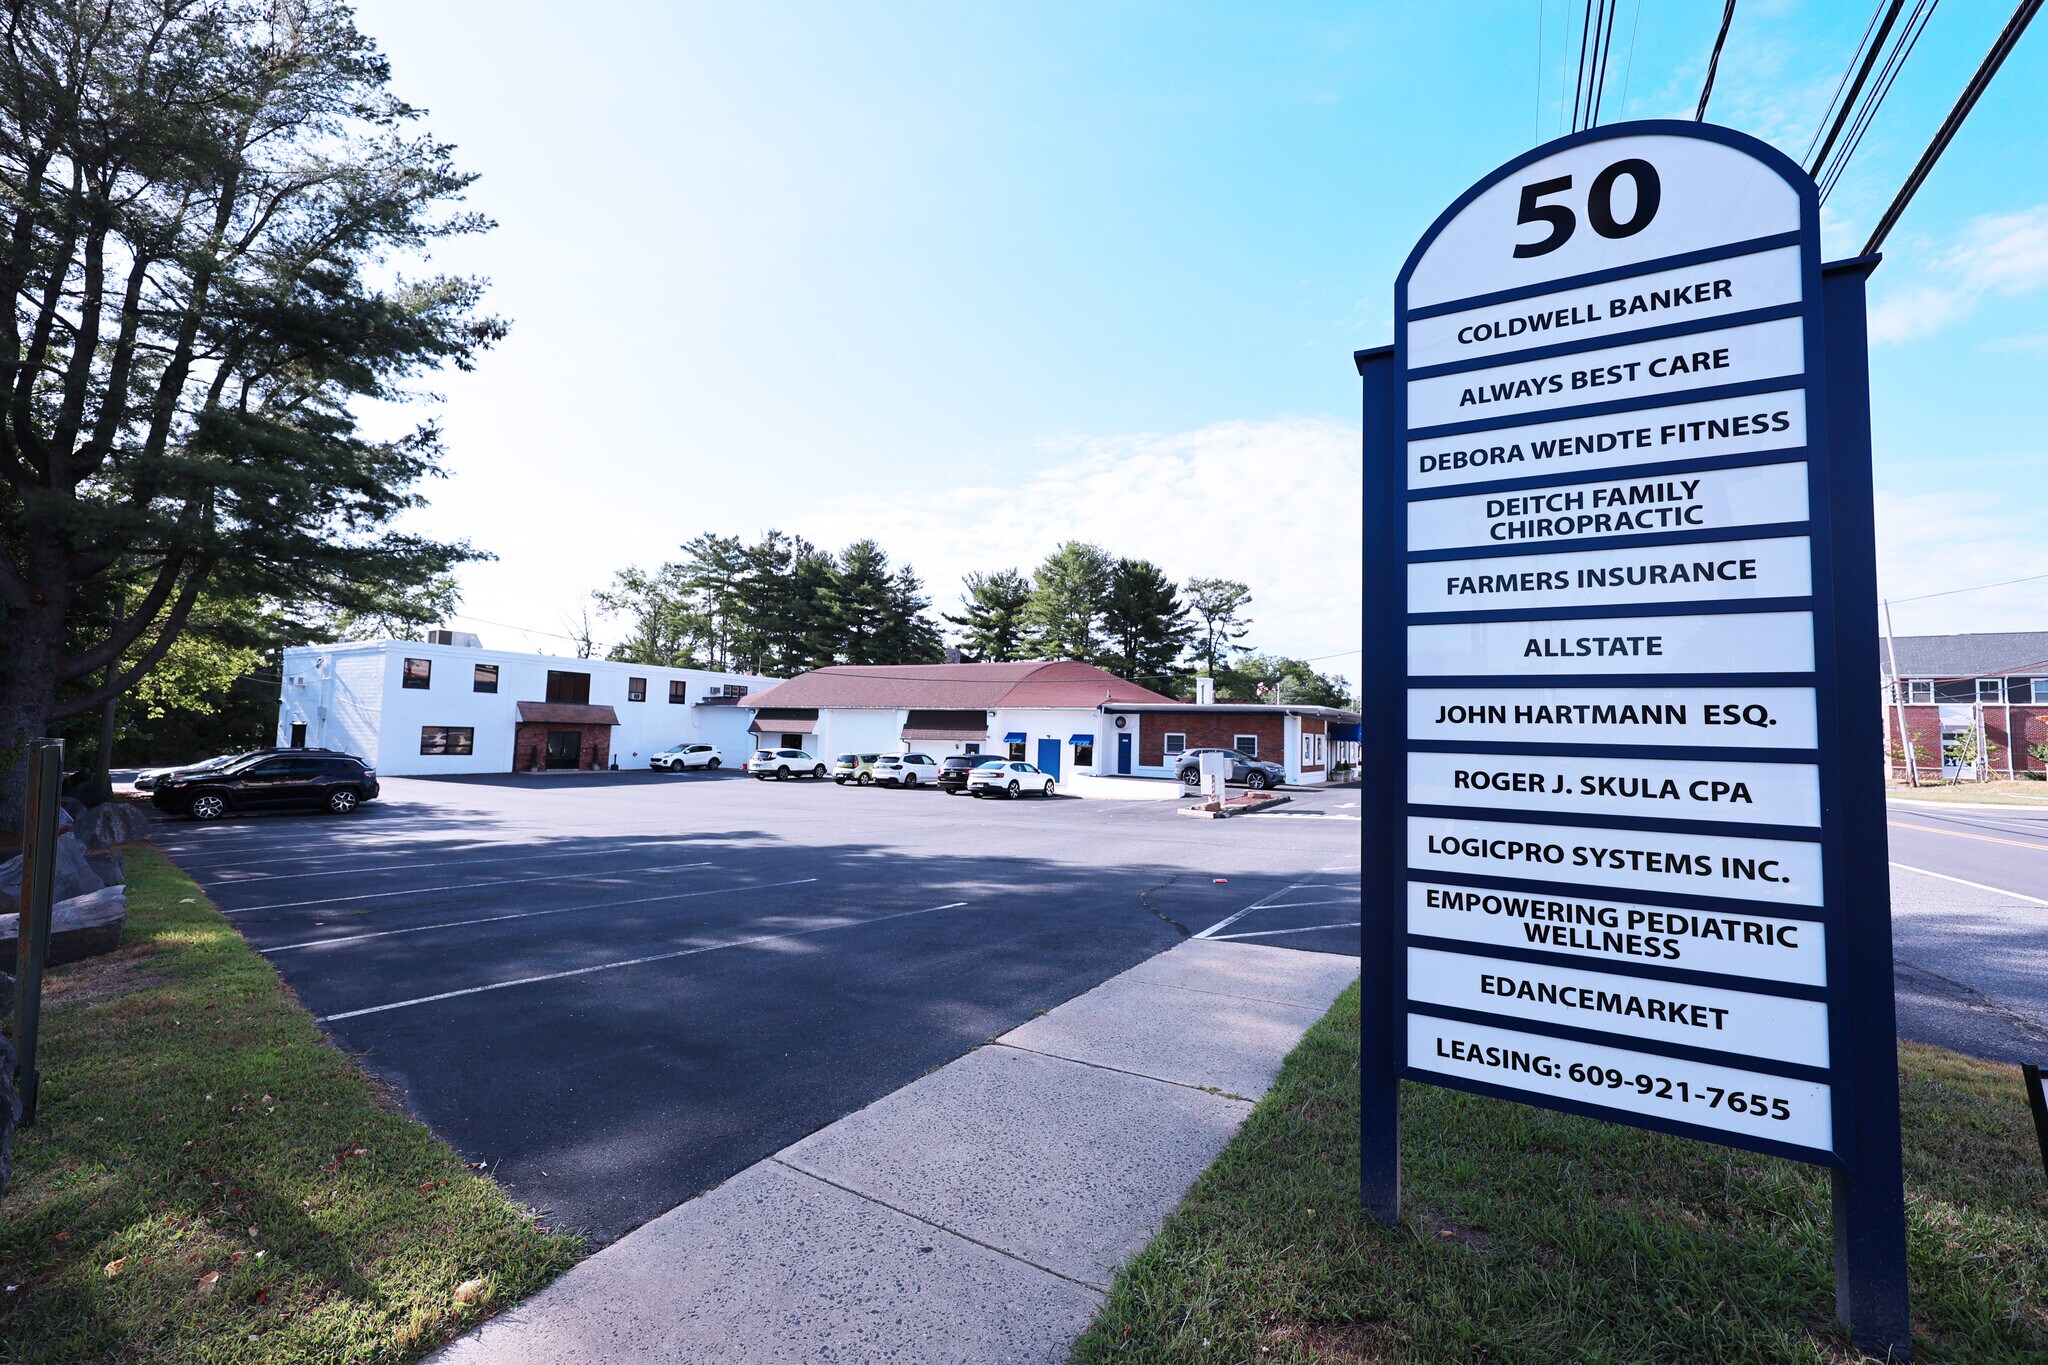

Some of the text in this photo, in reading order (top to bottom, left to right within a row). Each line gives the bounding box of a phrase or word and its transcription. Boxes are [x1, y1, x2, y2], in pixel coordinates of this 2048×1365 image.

[1513, 159, 1661, 258] 50
[1458, 279, 1732, 344] COLDWELL BANKER
[1460, 348, 1729, 407] ALWAYS BEST CARE
[1420, 411, 1790, 473] DEBORA WENDTE FITNESS
[1487, 480, 1700, 518] DEITCH FAMILY
[1489, 505, 1704, 541] CHIROPRACTIC
[1448, 559, 1756, 595] FARMERS INSURANCE
[1524, 636, 1662, 657] ALLSTATE
[1435, 704, 1776, 728] JOHN HARTMANN ESQ.
[1455, 770, 1753, 803] ROGER J. SKULA CPA
[1429, 835, 1789, 883] LOGICPRO SYSTEMS INC.
[1427, 889, 1798, 948] EMPOWERING PEDIATRIC
[1524, 922, 1680, 960] WELLNESS
[1481, 974, 1729, 1030] EDANCEMARKET
[1437, 1038, 1790, 1120] LEASING: 609-921-7655
